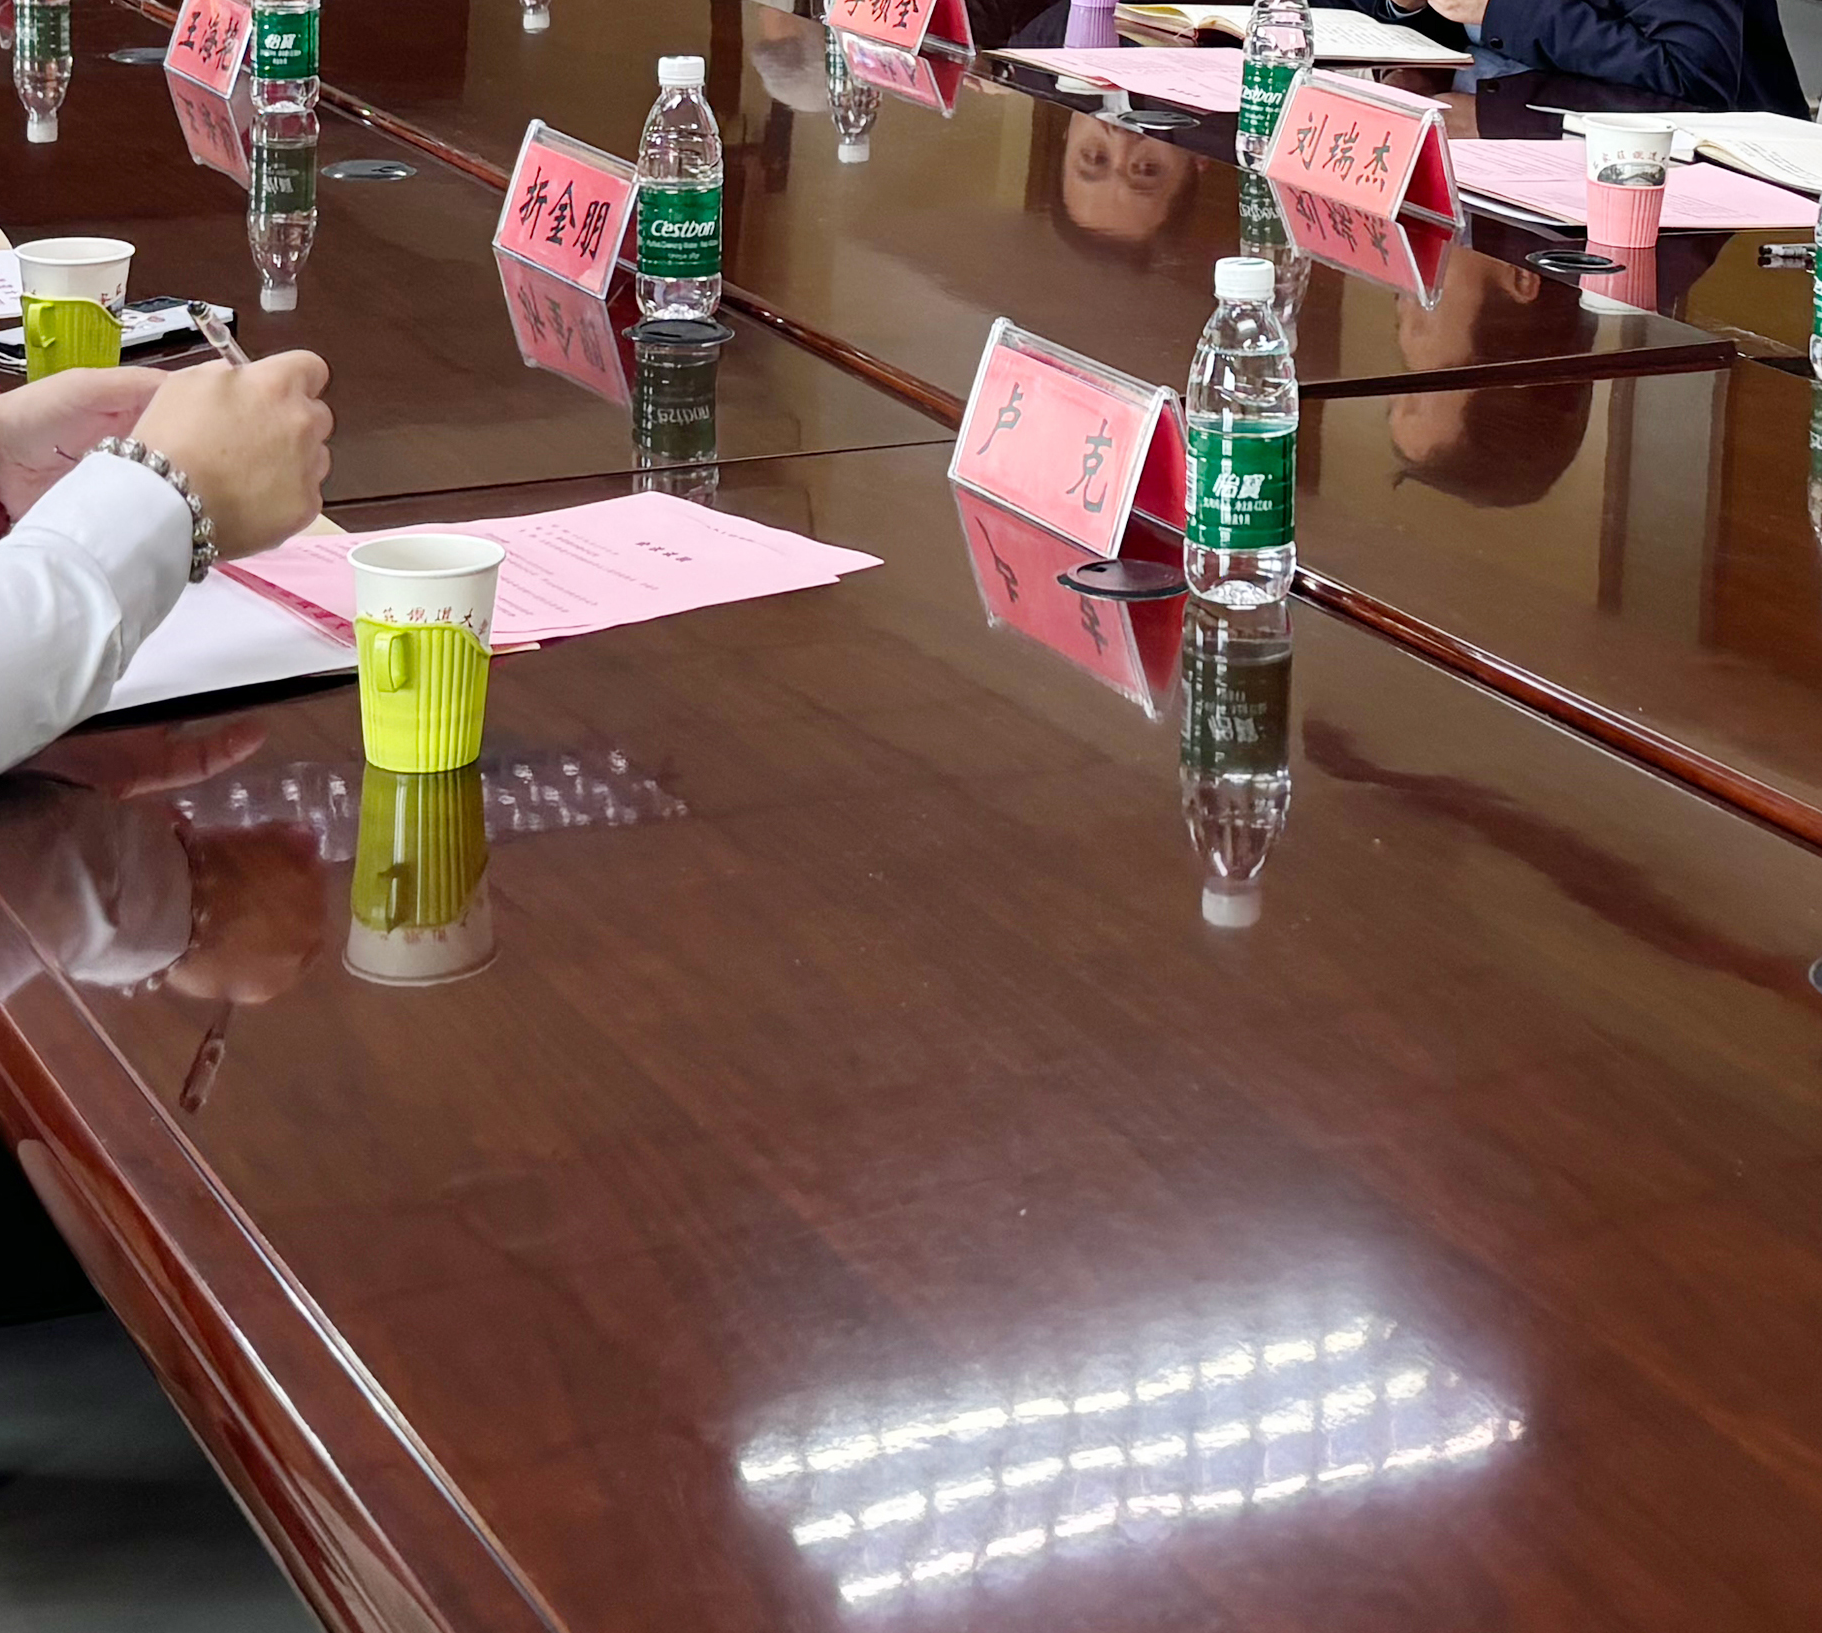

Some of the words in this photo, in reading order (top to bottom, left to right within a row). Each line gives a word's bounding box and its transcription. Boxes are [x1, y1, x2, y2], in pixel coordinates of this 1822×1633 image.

[1287, 110, 1392, 194] 刘瑞杰
[518, 165, 612, 262] 折金朋
[976, 381, 1114, 514] 卢克
